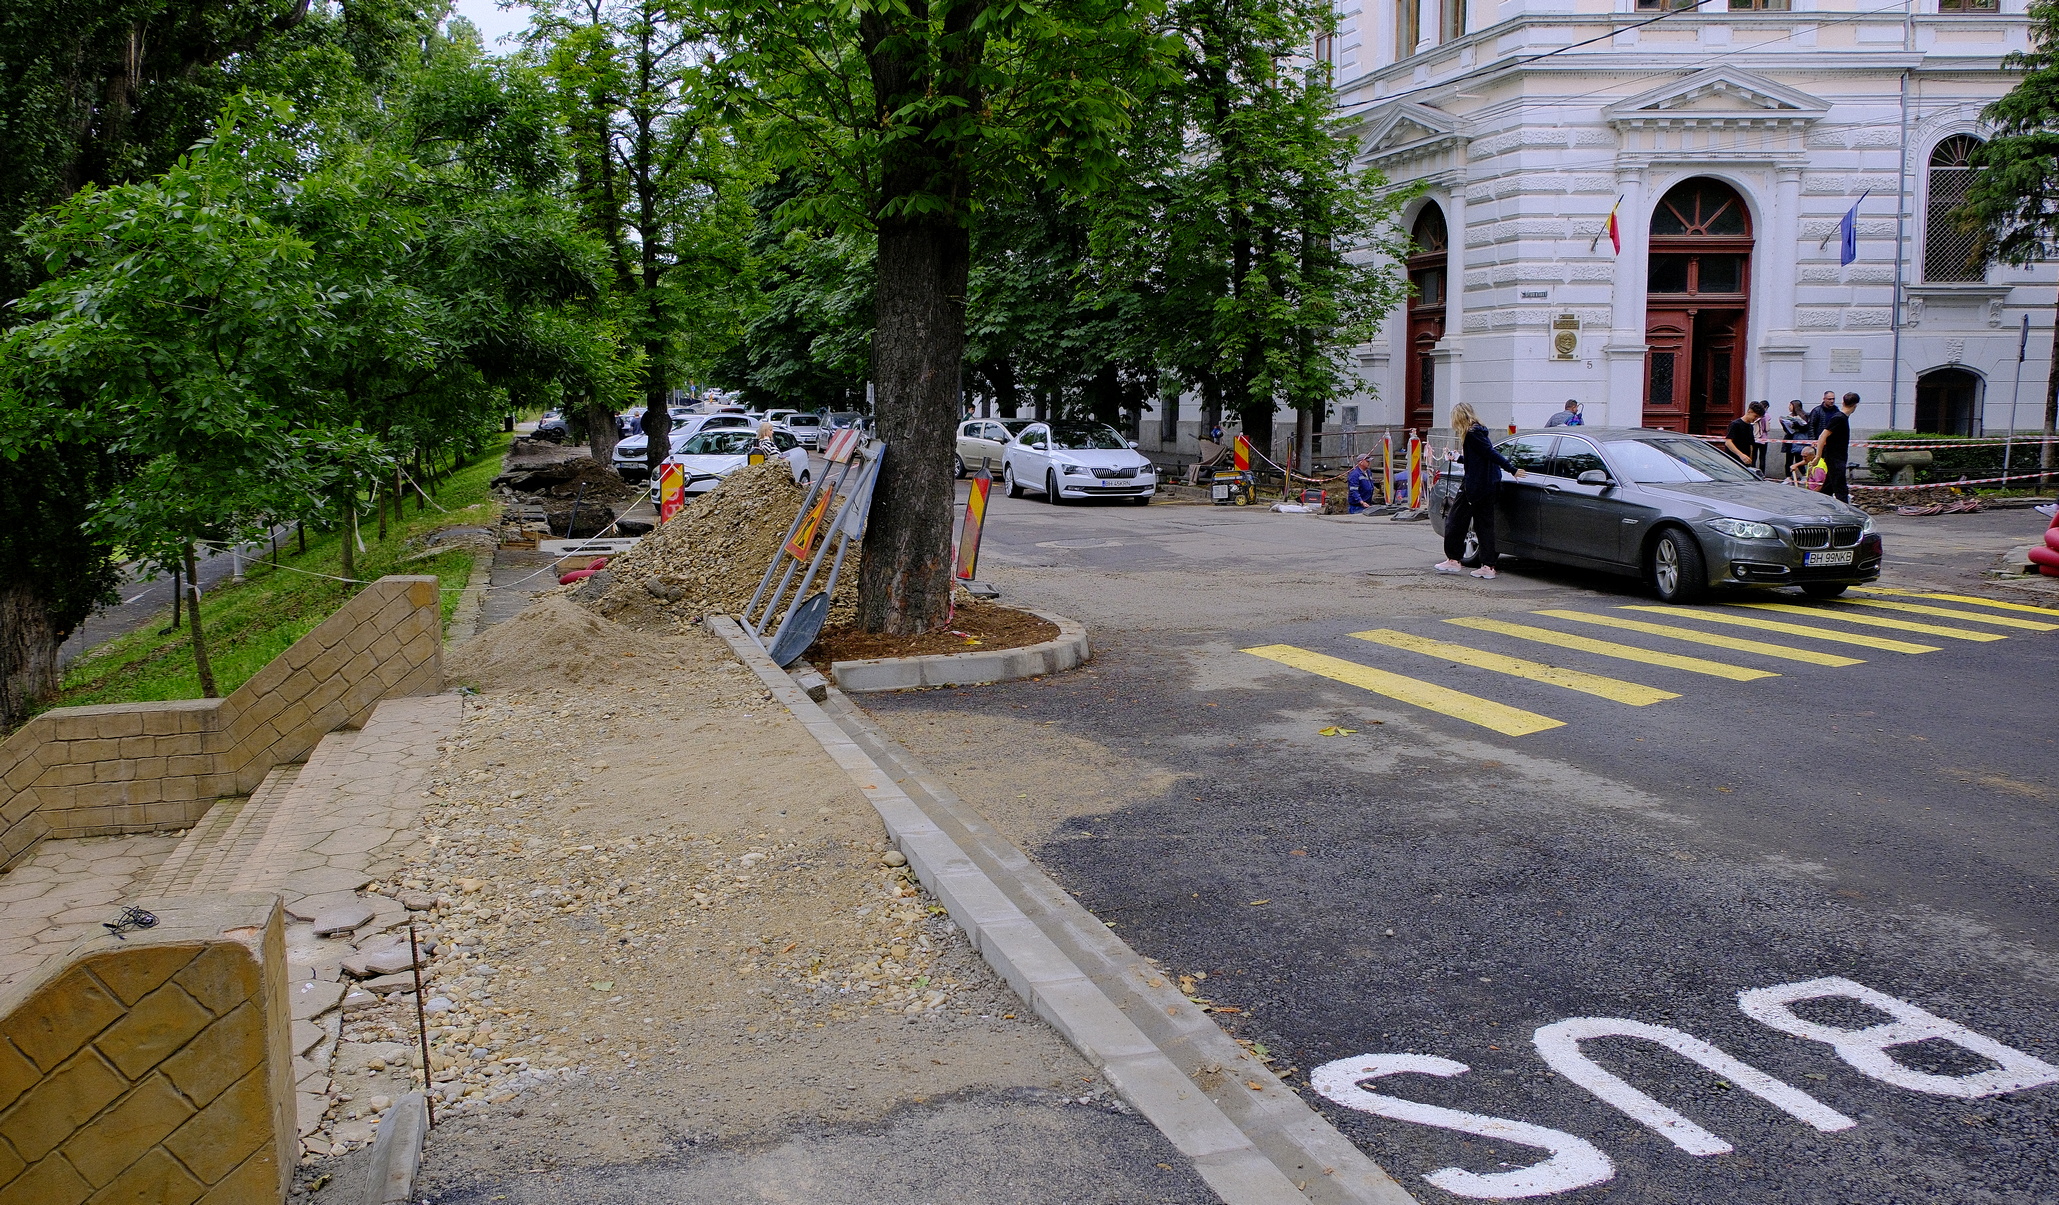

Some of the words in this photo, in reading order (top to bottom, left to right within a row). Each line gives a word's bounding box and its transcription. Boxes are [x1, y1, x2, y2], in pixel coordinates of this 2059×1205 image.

[1586, 361, 1593, 370] 5
[1809, 553, 1824, 564] BH
[1825, 551, 1853, 563] 99NKB
[1310, 976, 2059, 1199] BUS
